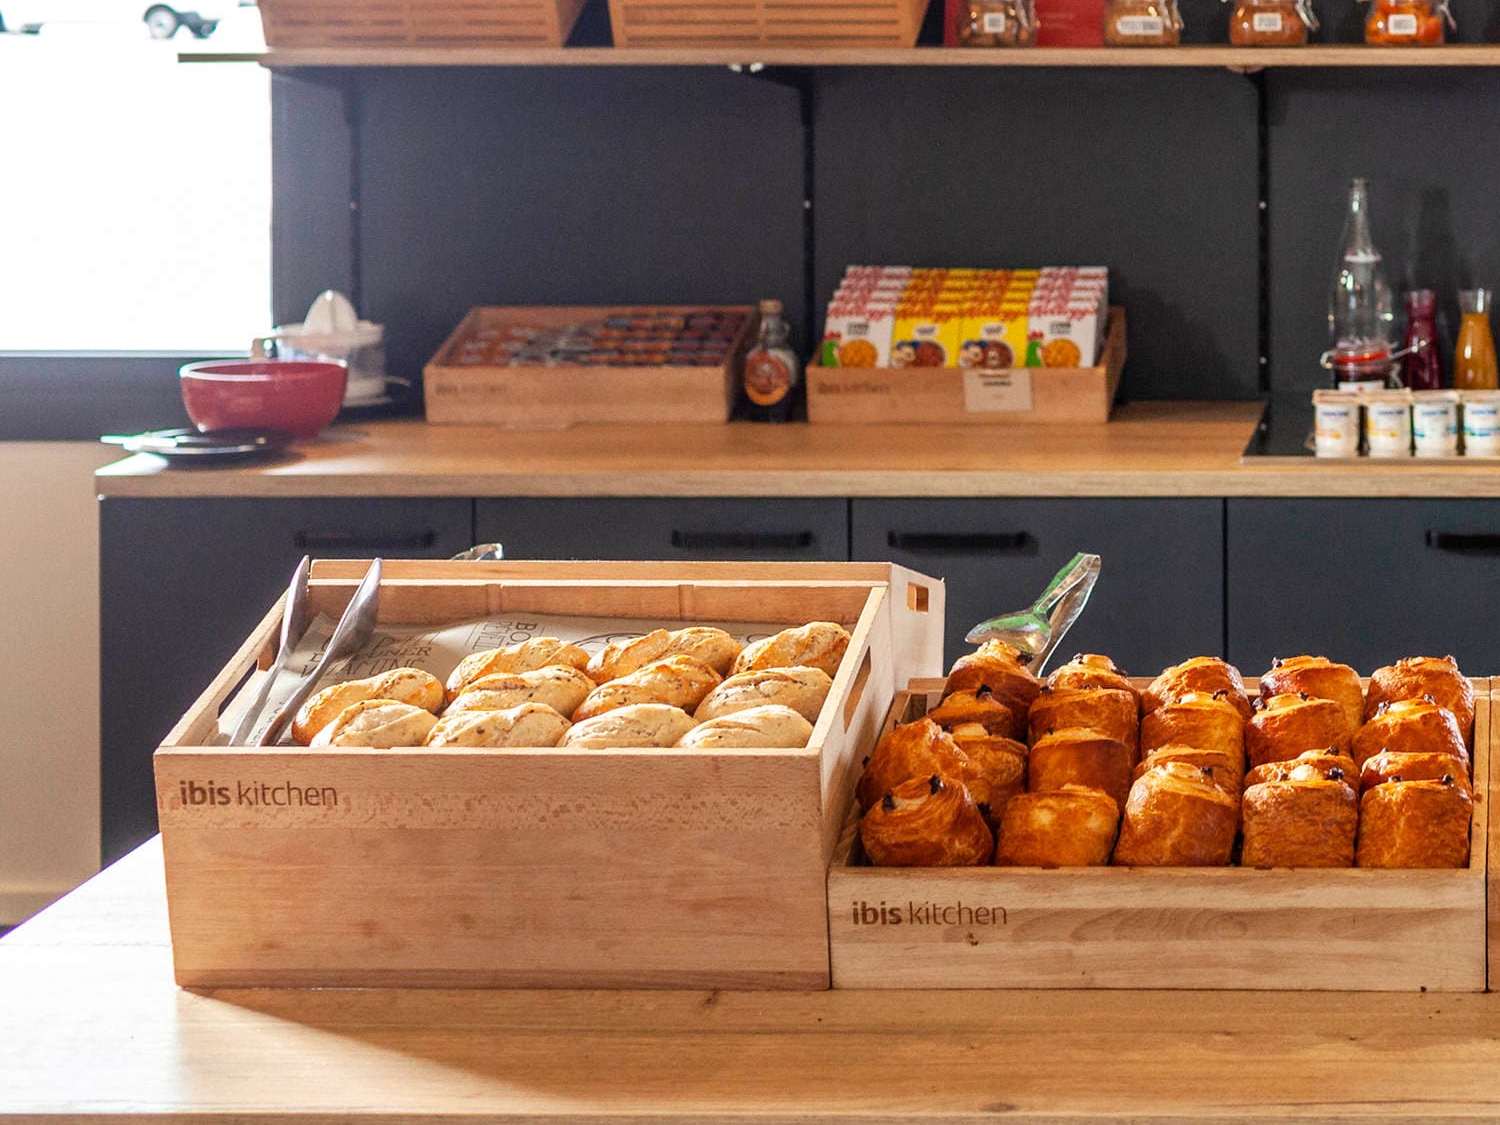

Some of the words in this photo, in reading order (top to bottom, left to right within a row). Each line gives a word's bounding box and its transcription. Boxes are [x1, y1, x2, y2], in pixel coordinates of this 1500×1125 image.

[180, 780, 232, 806] ibis
[237, 780, 338, 806] kitchen
[852, 901, 902, 925] ibis
[909, 901, 1008, 925] kitchen
